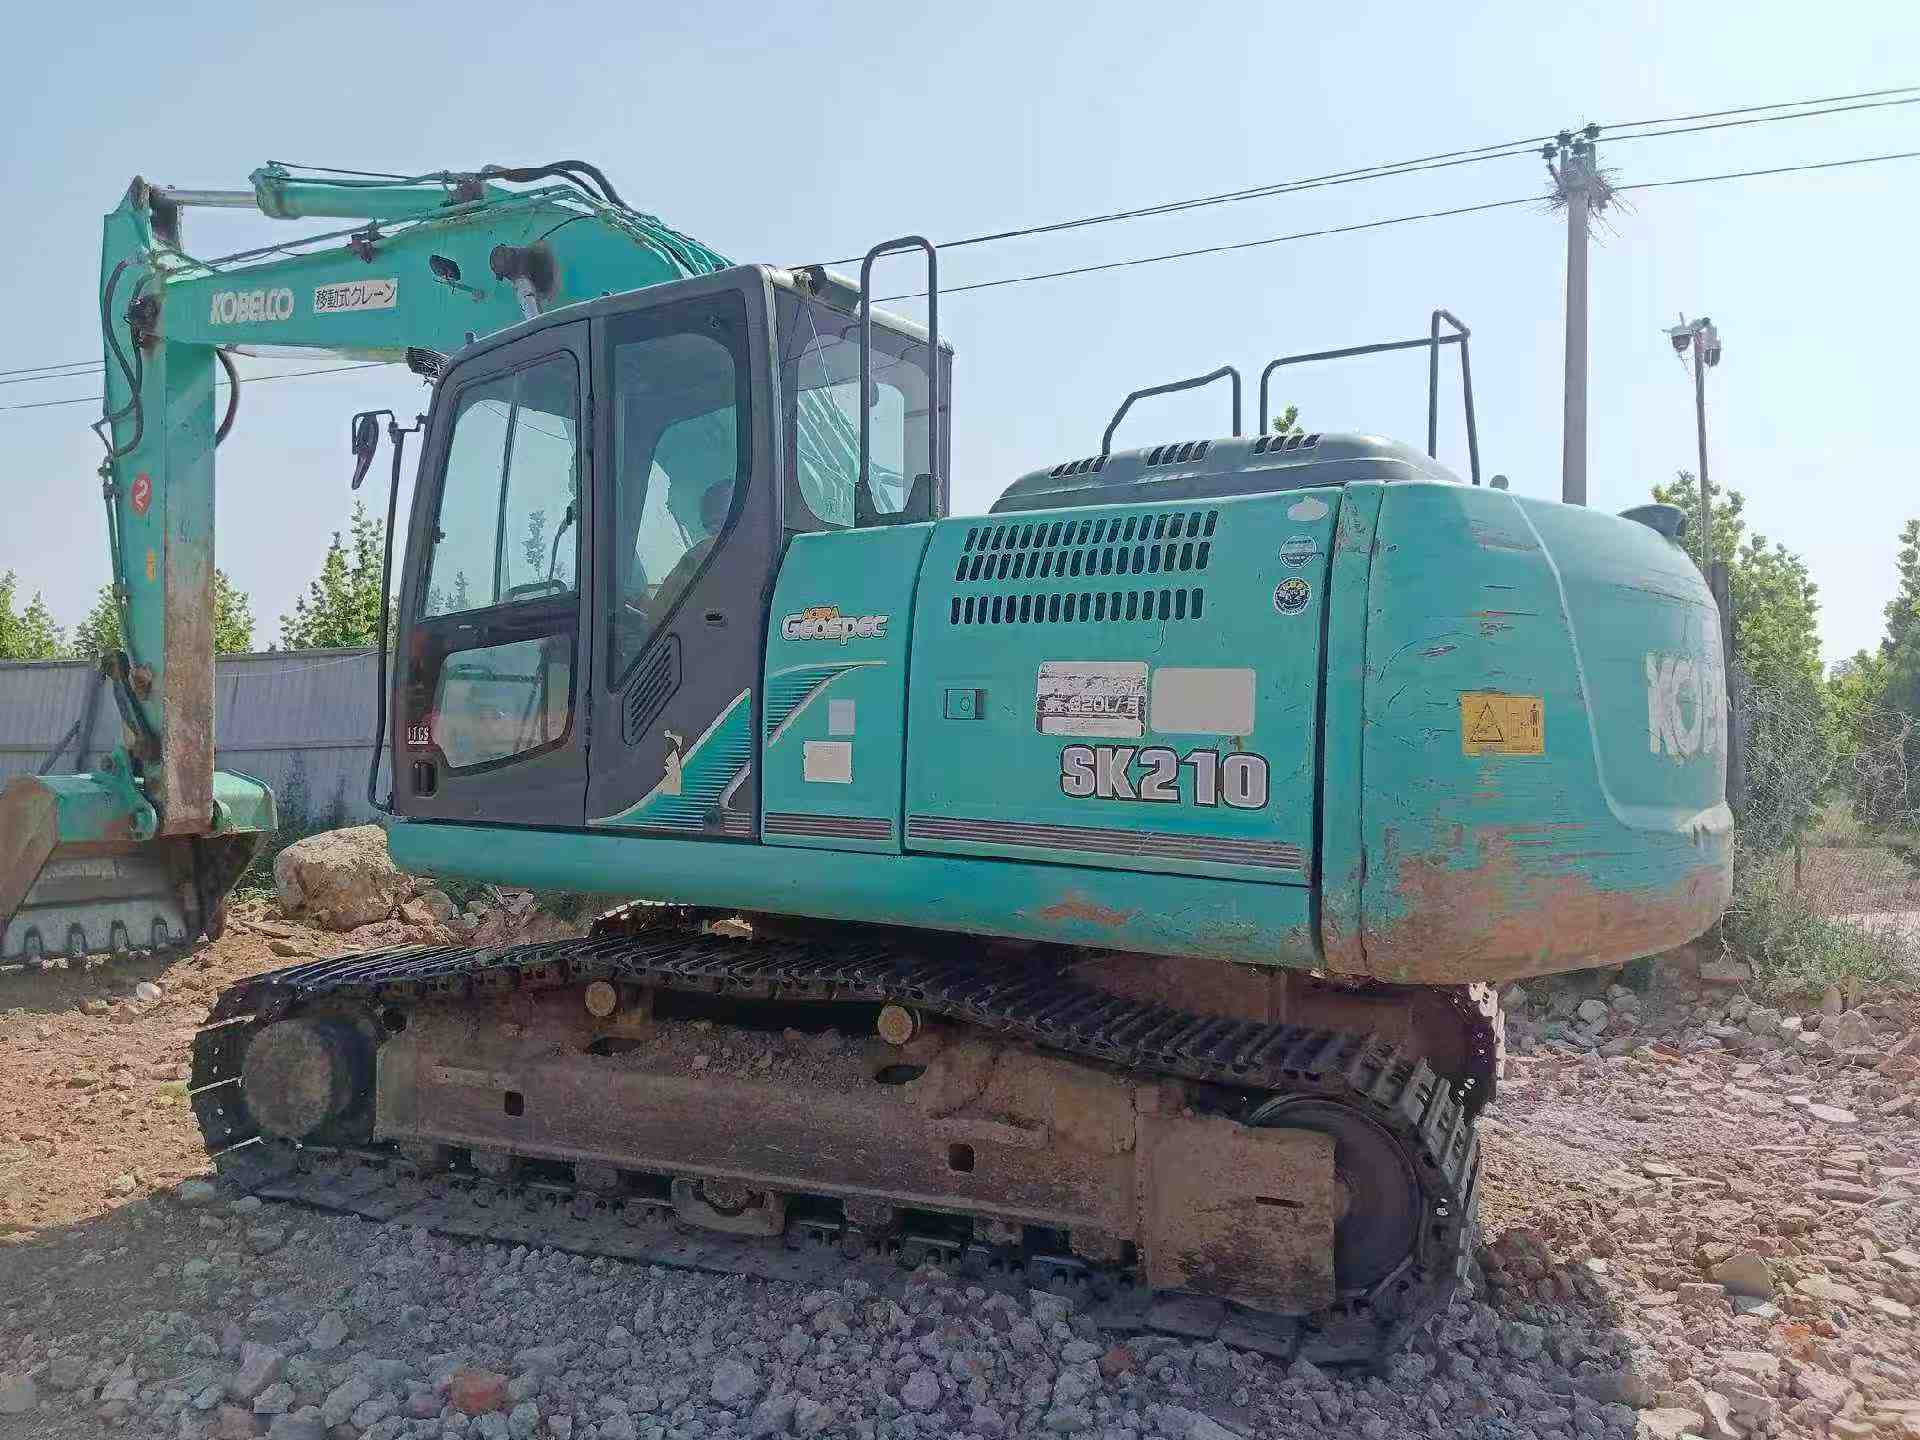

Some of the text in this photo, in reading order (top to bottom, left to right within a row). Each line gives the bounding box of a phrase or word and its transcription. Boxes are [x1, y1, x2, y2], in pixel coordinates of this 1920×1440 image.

[209, 288, 294, 324] KOBELCO
[314, 281, 395, 310] 移動式クレーン
[781, 613, 888, 646] Geospec
[1061, 744, 1270, 810] SK210
